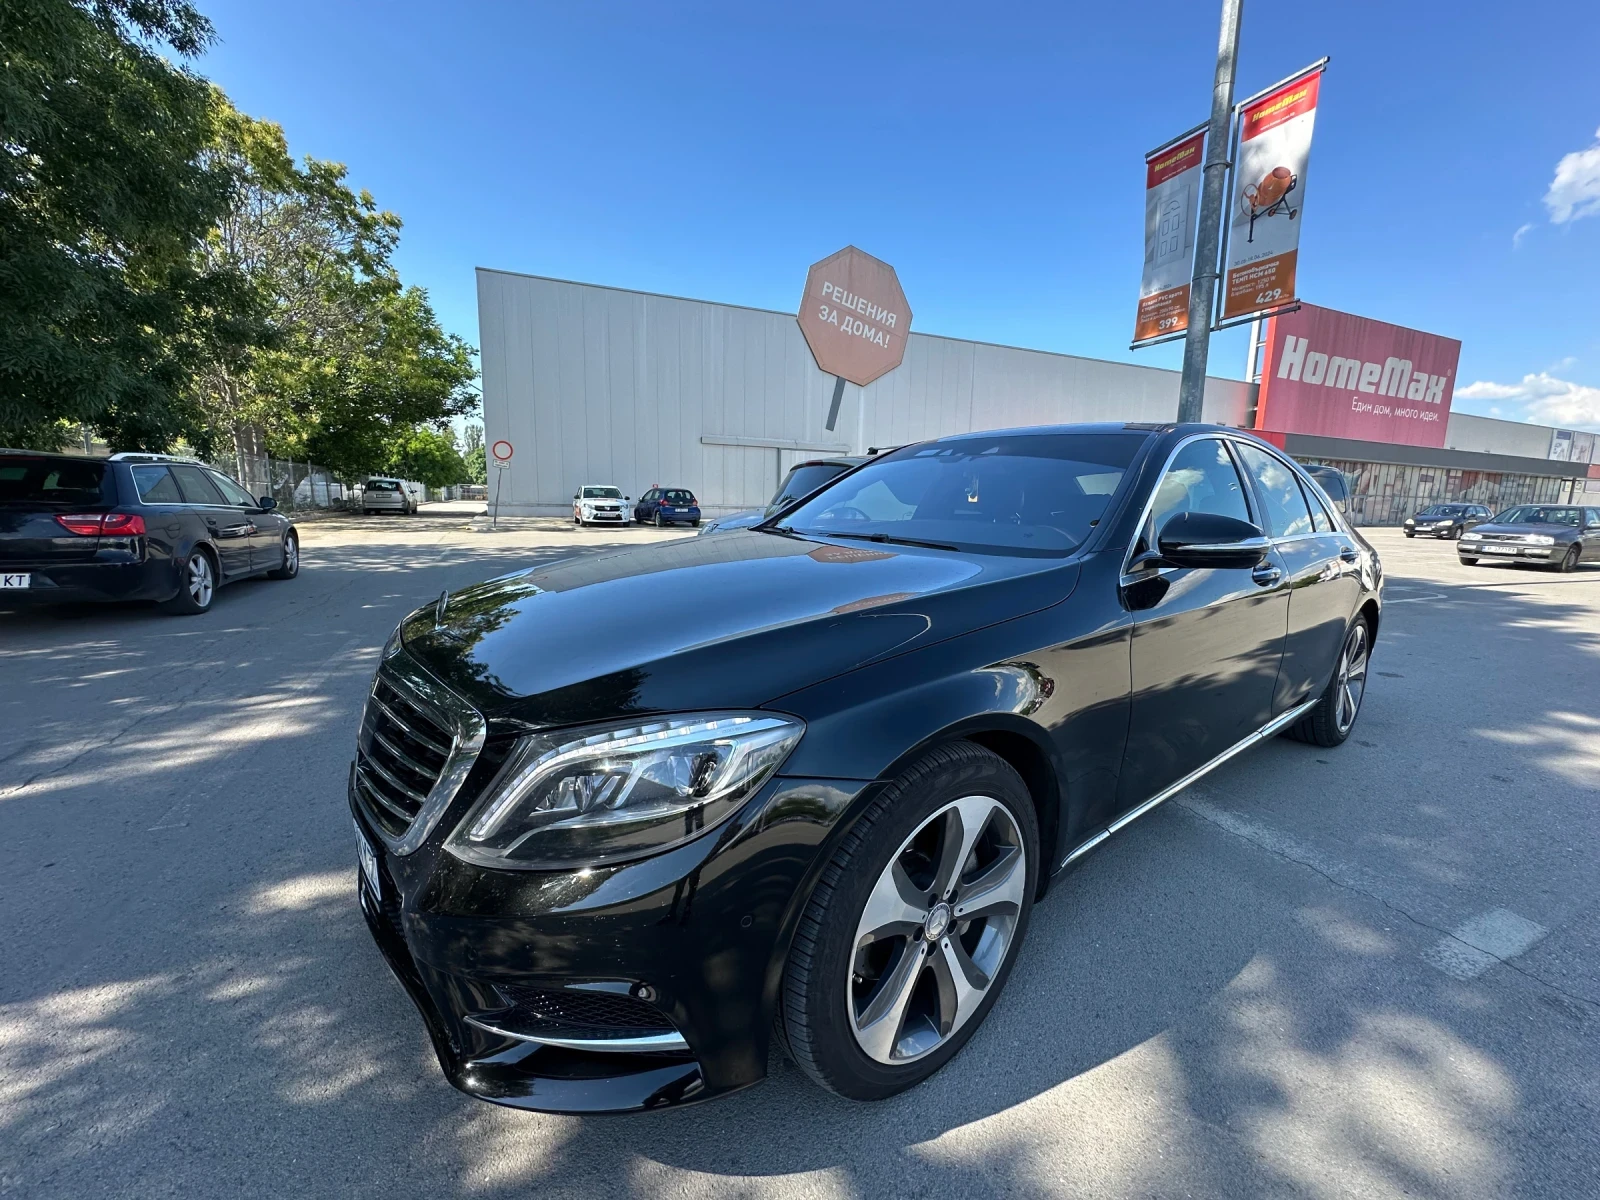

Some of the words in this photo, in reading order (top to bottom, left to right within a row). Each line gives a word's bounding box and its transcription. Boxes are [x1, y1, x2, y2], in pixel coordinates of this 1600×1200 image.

[822, 281, 897, 328] РЕШЕНИЯ
[1255, 288, 1282, 304] 429
[818, 305, 838, 326] ЗА
[840, 316, 890, 348] ДОМА!
[1159, 316, 1178, 329] 399
[1277, 334, 1447, 405] HomeMax
[1351, 396, 1372, 413] Един
[1373, 404, 1392, 418] дом,
[1394, 407, 1419, 419] много
[1419, 410, 1439, 422] идеи.
[3, 574, 26, 587] KT
